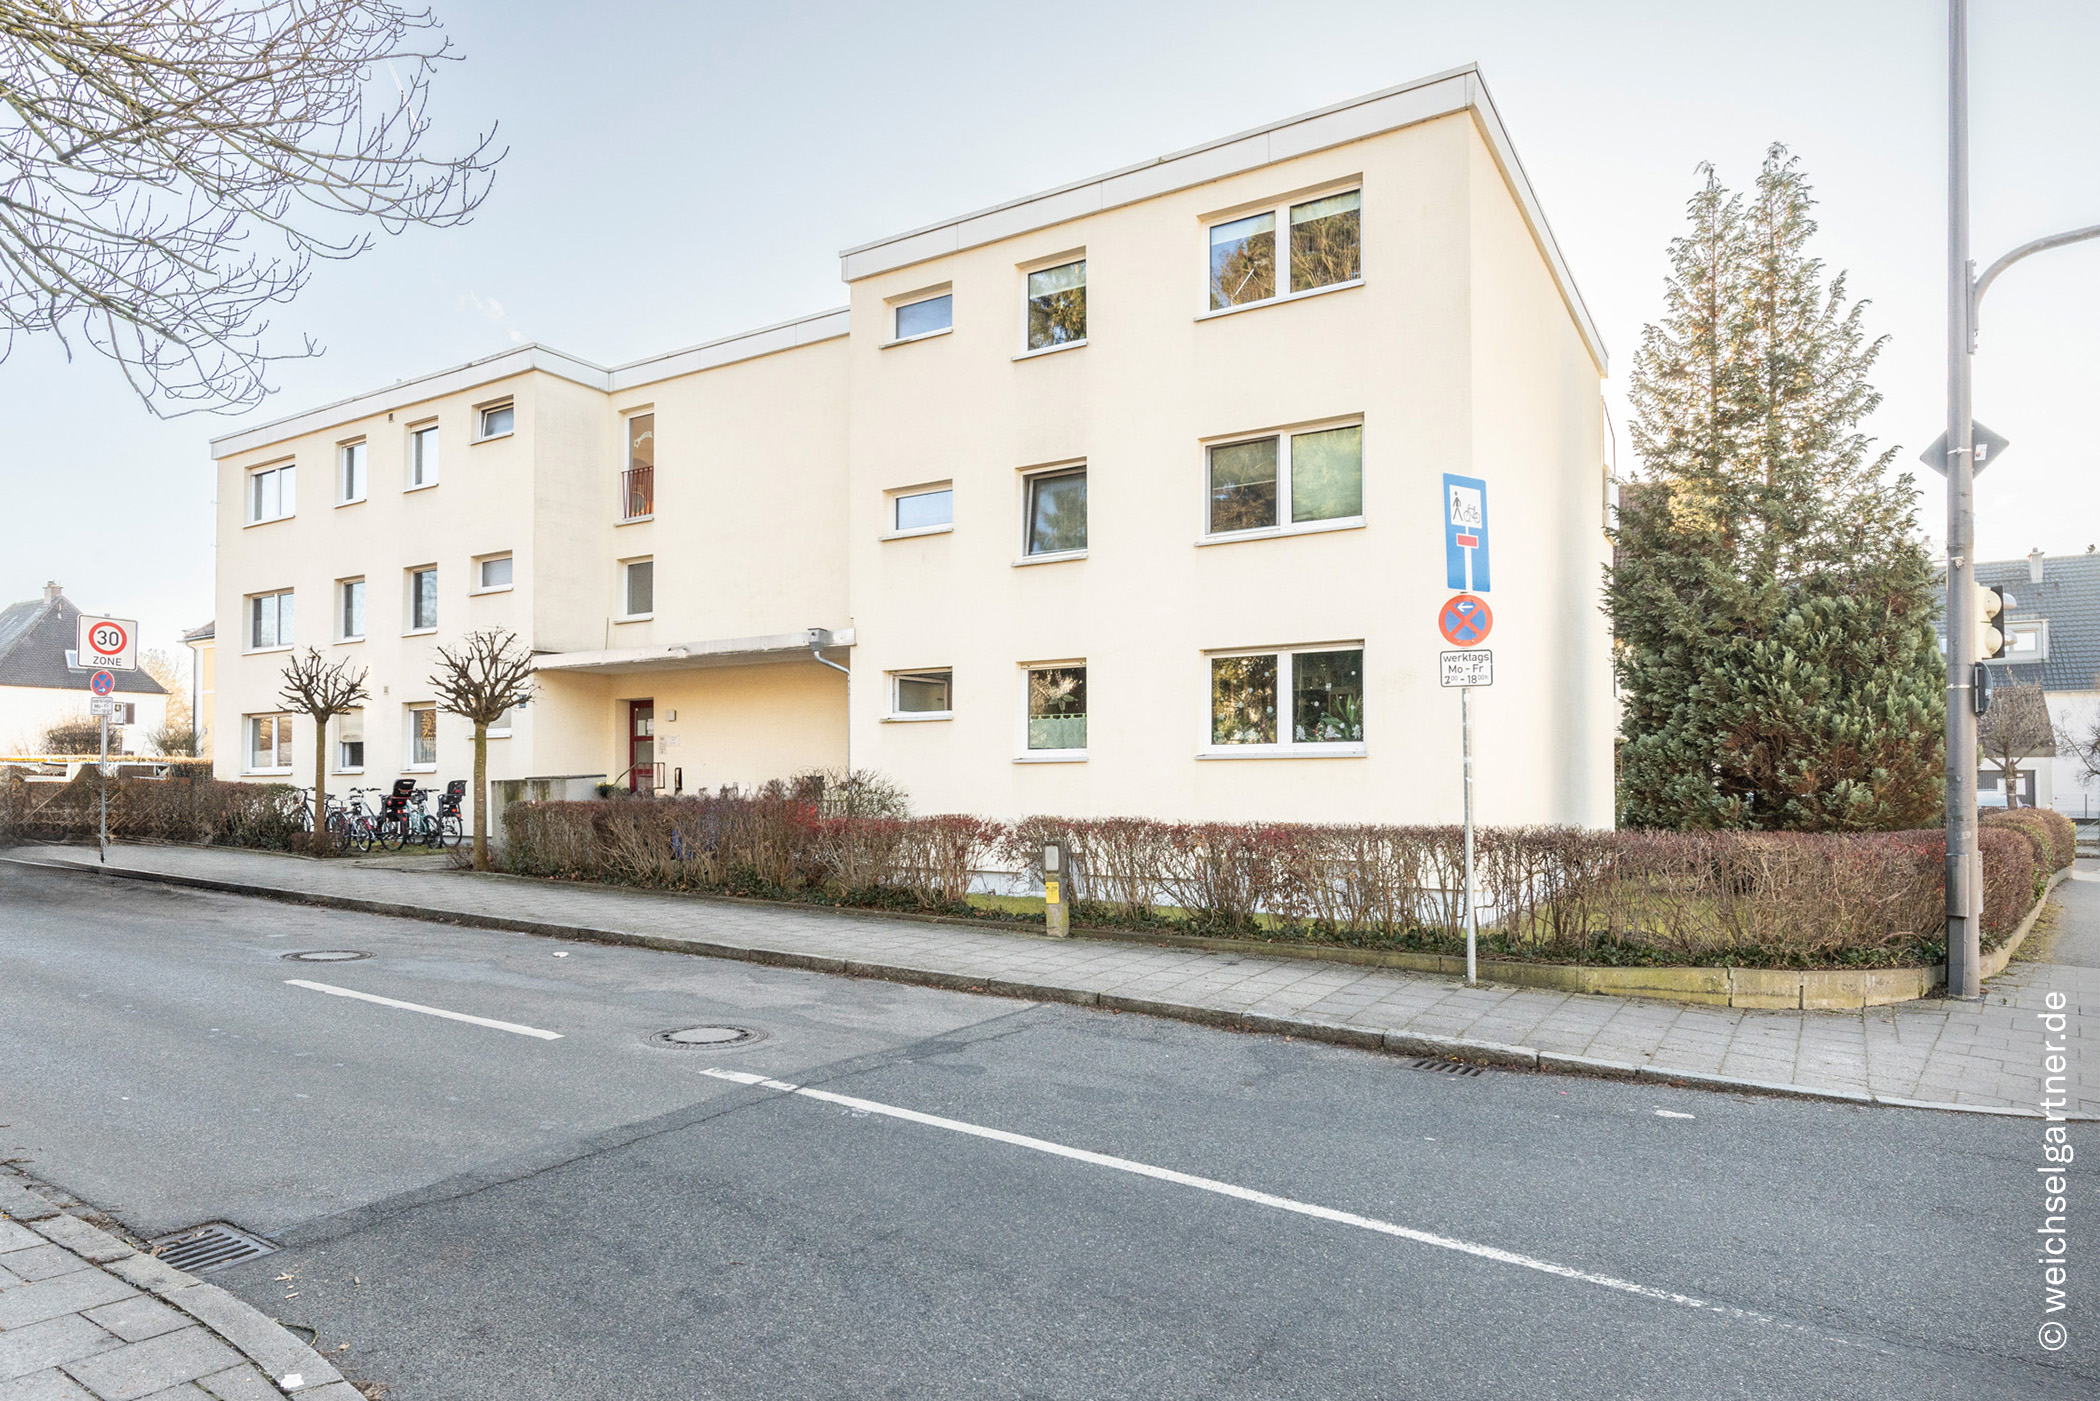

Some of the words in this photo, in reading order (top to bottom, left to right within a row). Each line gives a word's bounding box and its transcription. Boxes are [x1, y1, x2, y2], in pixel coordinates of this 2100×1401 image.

[97, 630, 119, 646] 30
[93, 656, 122, 666] ZONE
[1443, 653, 1489, 663] werktags
[1448, 664, 1463, 674] Mo
[1472, 664, 1483, 672] Fr
